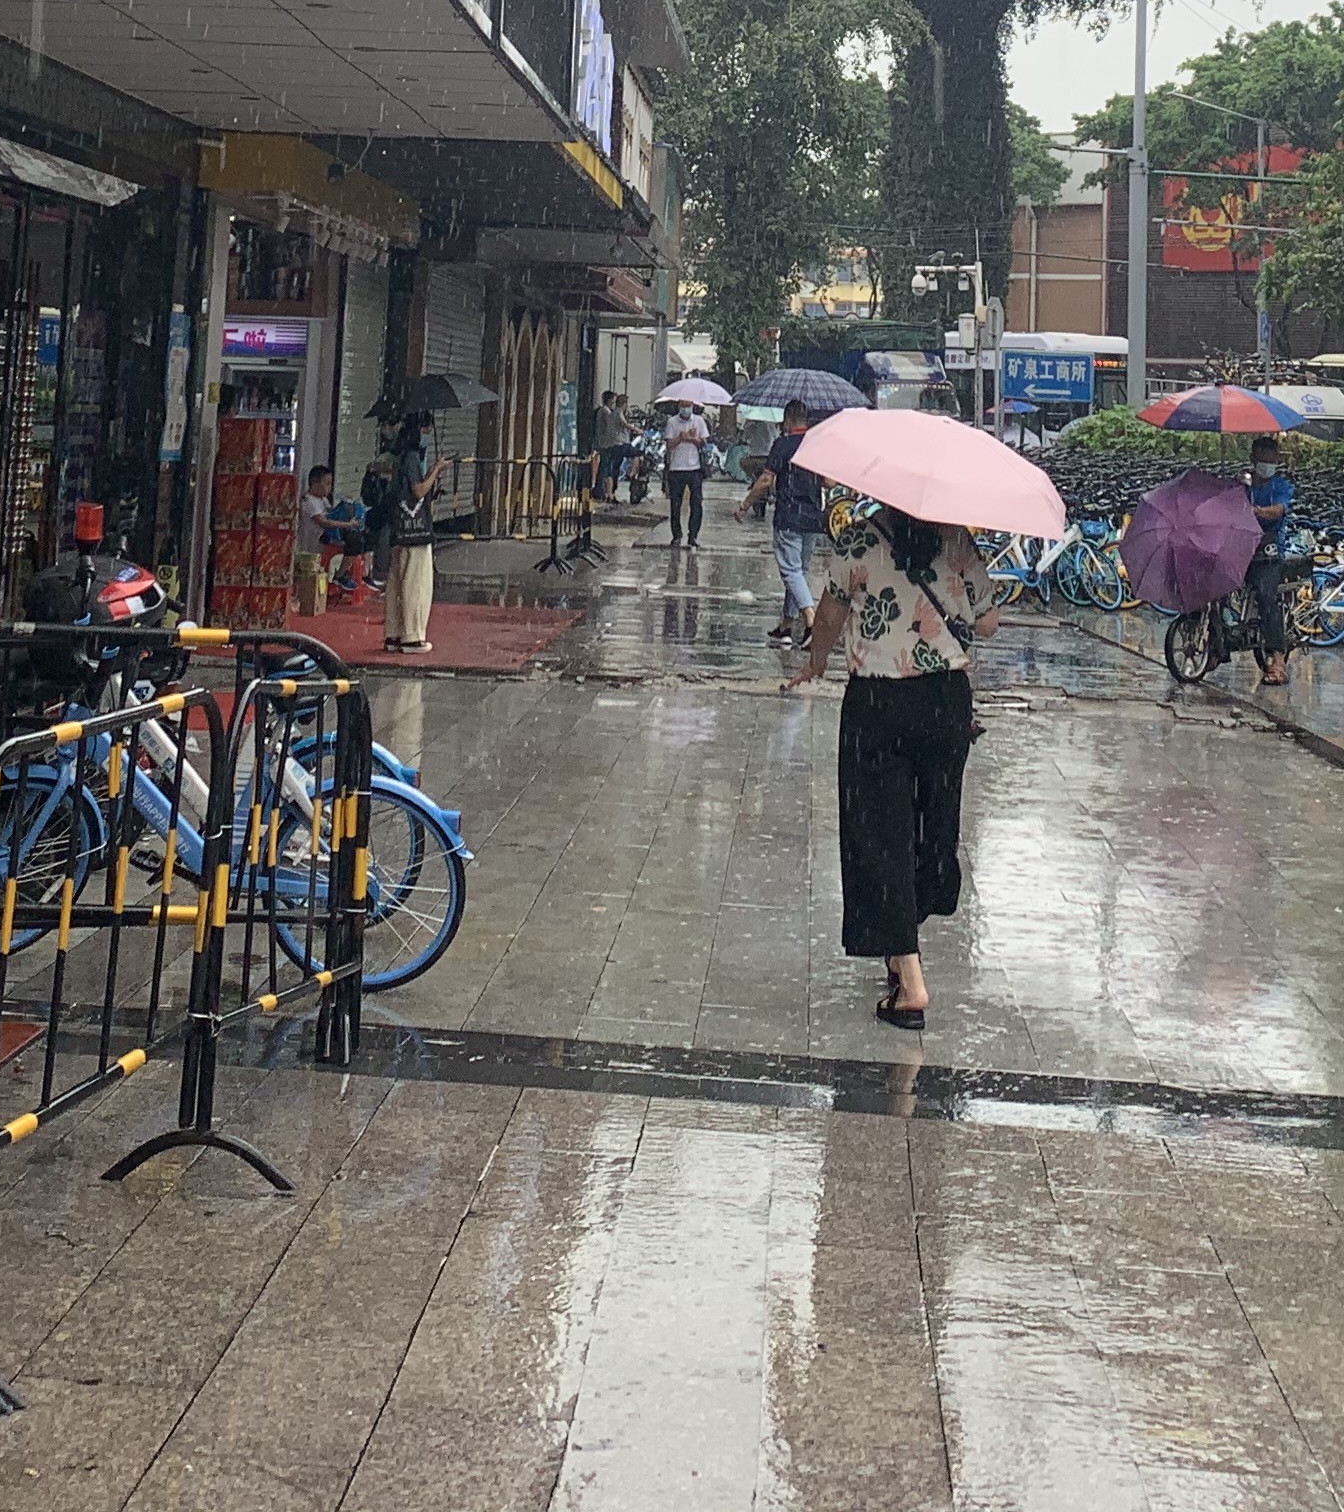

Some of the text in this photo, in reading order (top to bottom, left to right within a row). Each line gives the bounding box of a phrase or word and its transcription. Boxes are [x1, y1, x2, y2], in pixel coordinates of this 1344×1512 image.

[1008, 357, 1087, 382] 矿泉工商所
